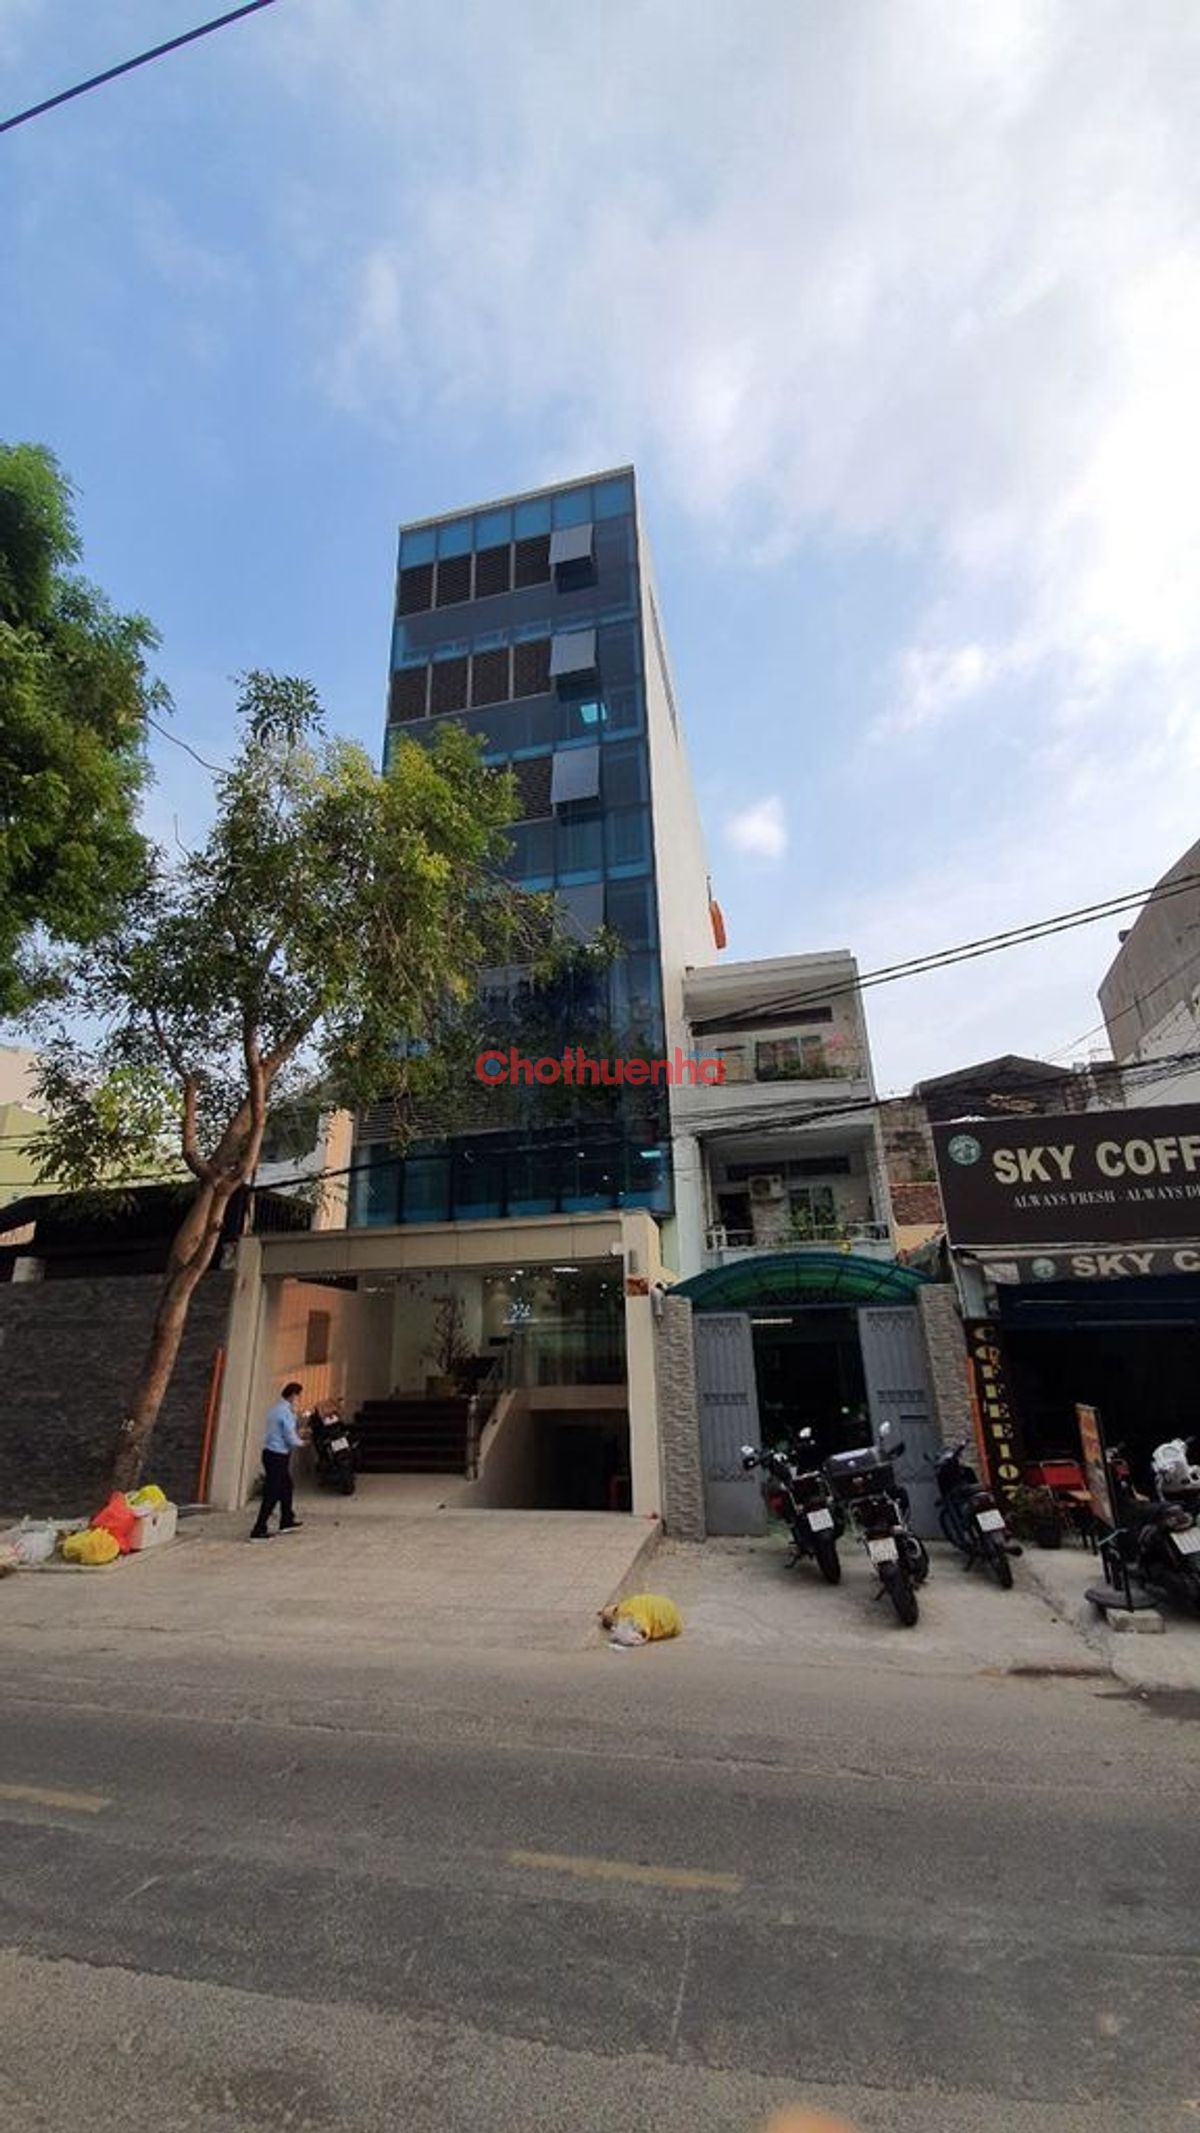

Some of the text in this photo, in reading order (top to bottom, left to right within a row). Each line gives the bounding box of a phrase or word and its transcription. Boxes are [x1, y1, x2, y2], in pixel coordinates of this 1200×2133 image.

[993, 1135, 1200, 1184] SKY COFF
[1013, 1193, 1067, 1208] ALWAYS
[1069, 1190, 1116, 1206] FRESH
[1127, 1185, 1182, 1202] ALWAYS
[1071, 1252, 1155, 1278] SKY
